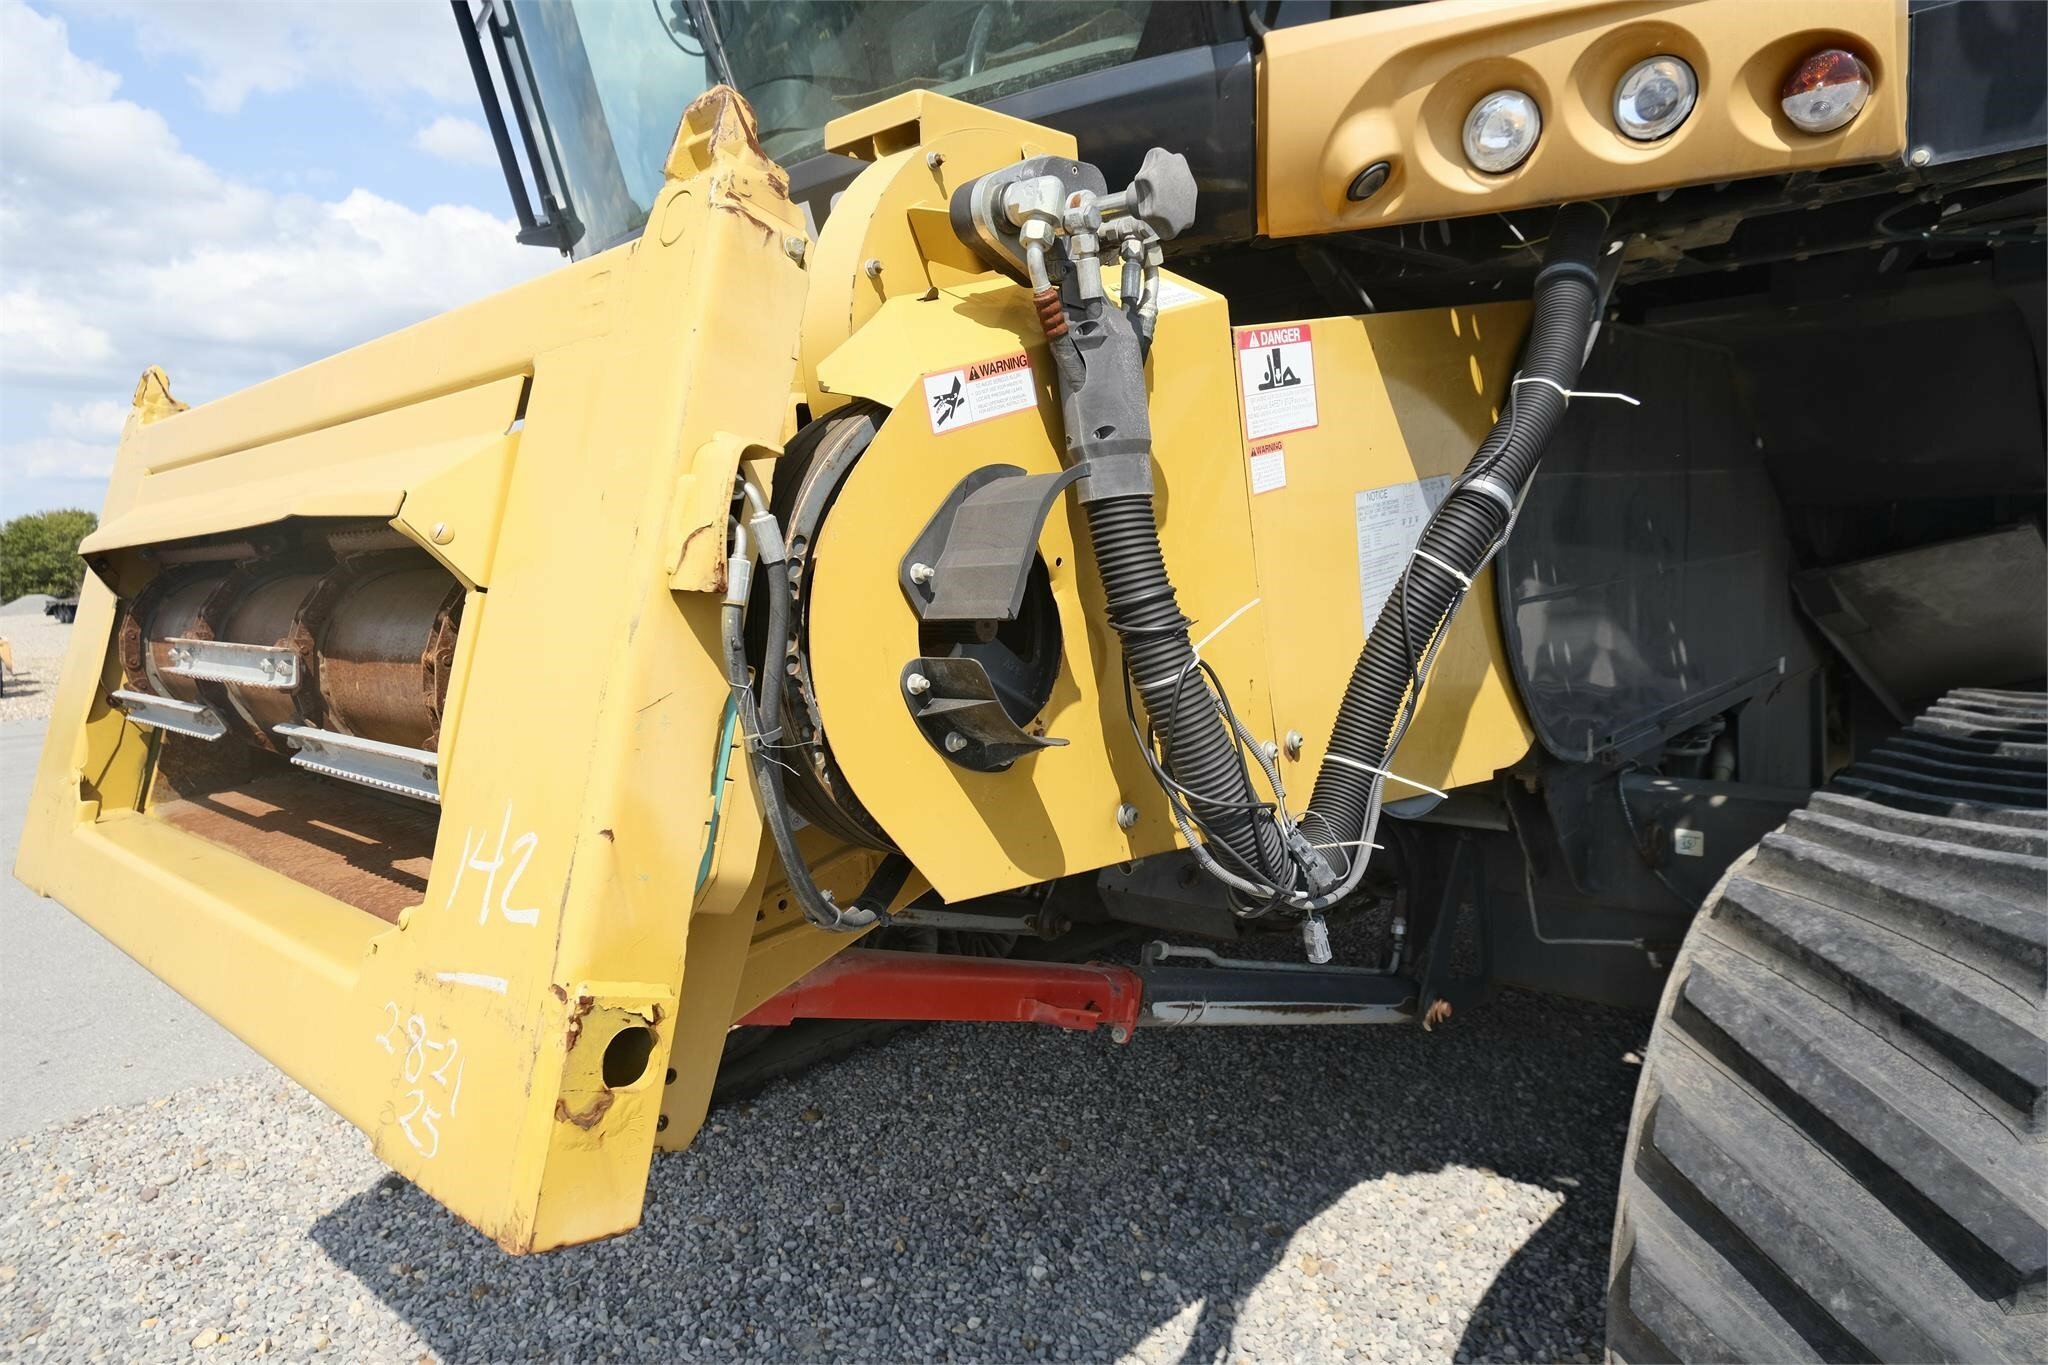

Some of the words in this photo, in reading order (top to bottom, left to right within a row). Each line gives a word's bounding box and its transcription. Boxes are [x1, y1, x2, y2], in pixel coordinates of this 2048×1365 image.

[1260, 328, 1301, 346] DANGER
[979, 354, 1028, 377] WARNING
[1256, 441, 1282, 456] WARNING
[1366, 488, 1388, 502] NOTICE
[447, 800, 540, 927] 142
[400, 1088, 441, 1159] 25
